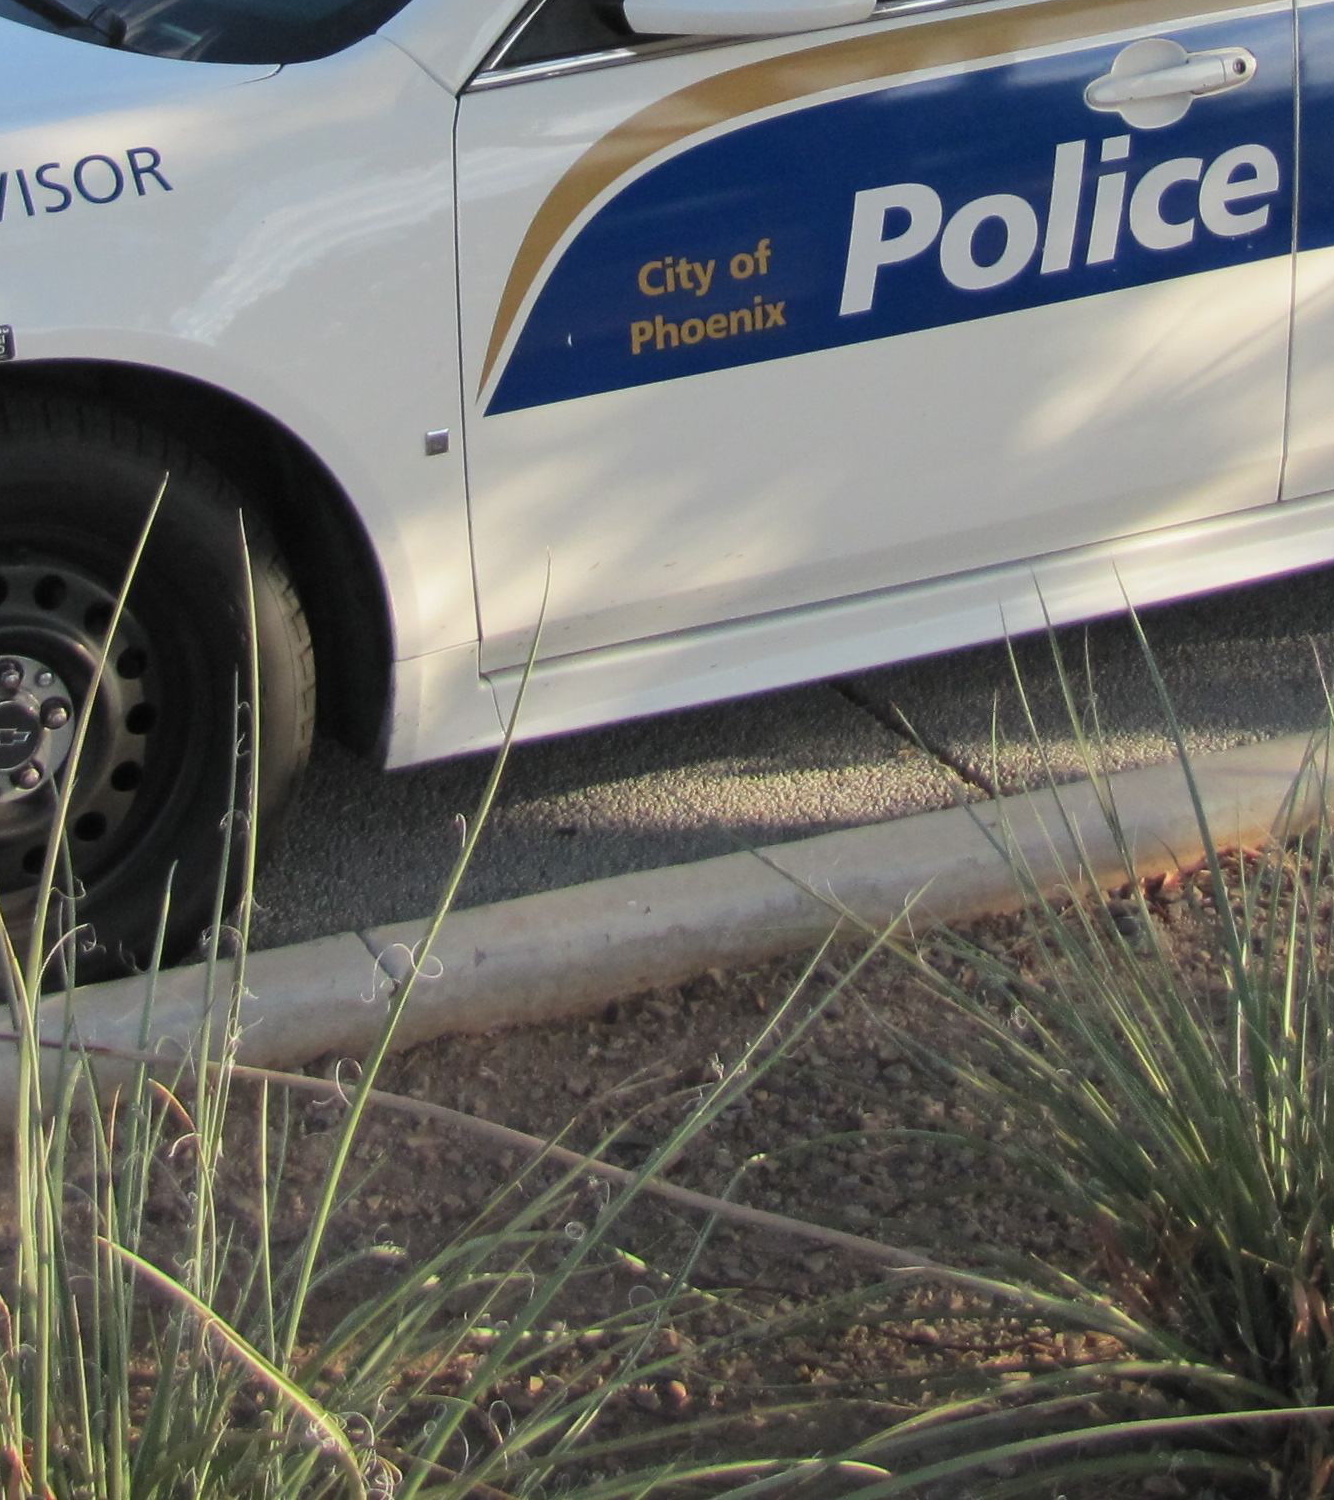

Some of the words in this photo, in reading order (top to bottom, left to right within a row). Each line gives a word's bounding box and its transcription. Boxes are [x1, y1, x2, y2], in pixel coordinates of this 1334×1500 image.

[839, 134, 1279, 316] Police
[638, 256, 716, 296] City
[730, 238, 771, 279] of
[630, 295, 787, 355] Phoenix
